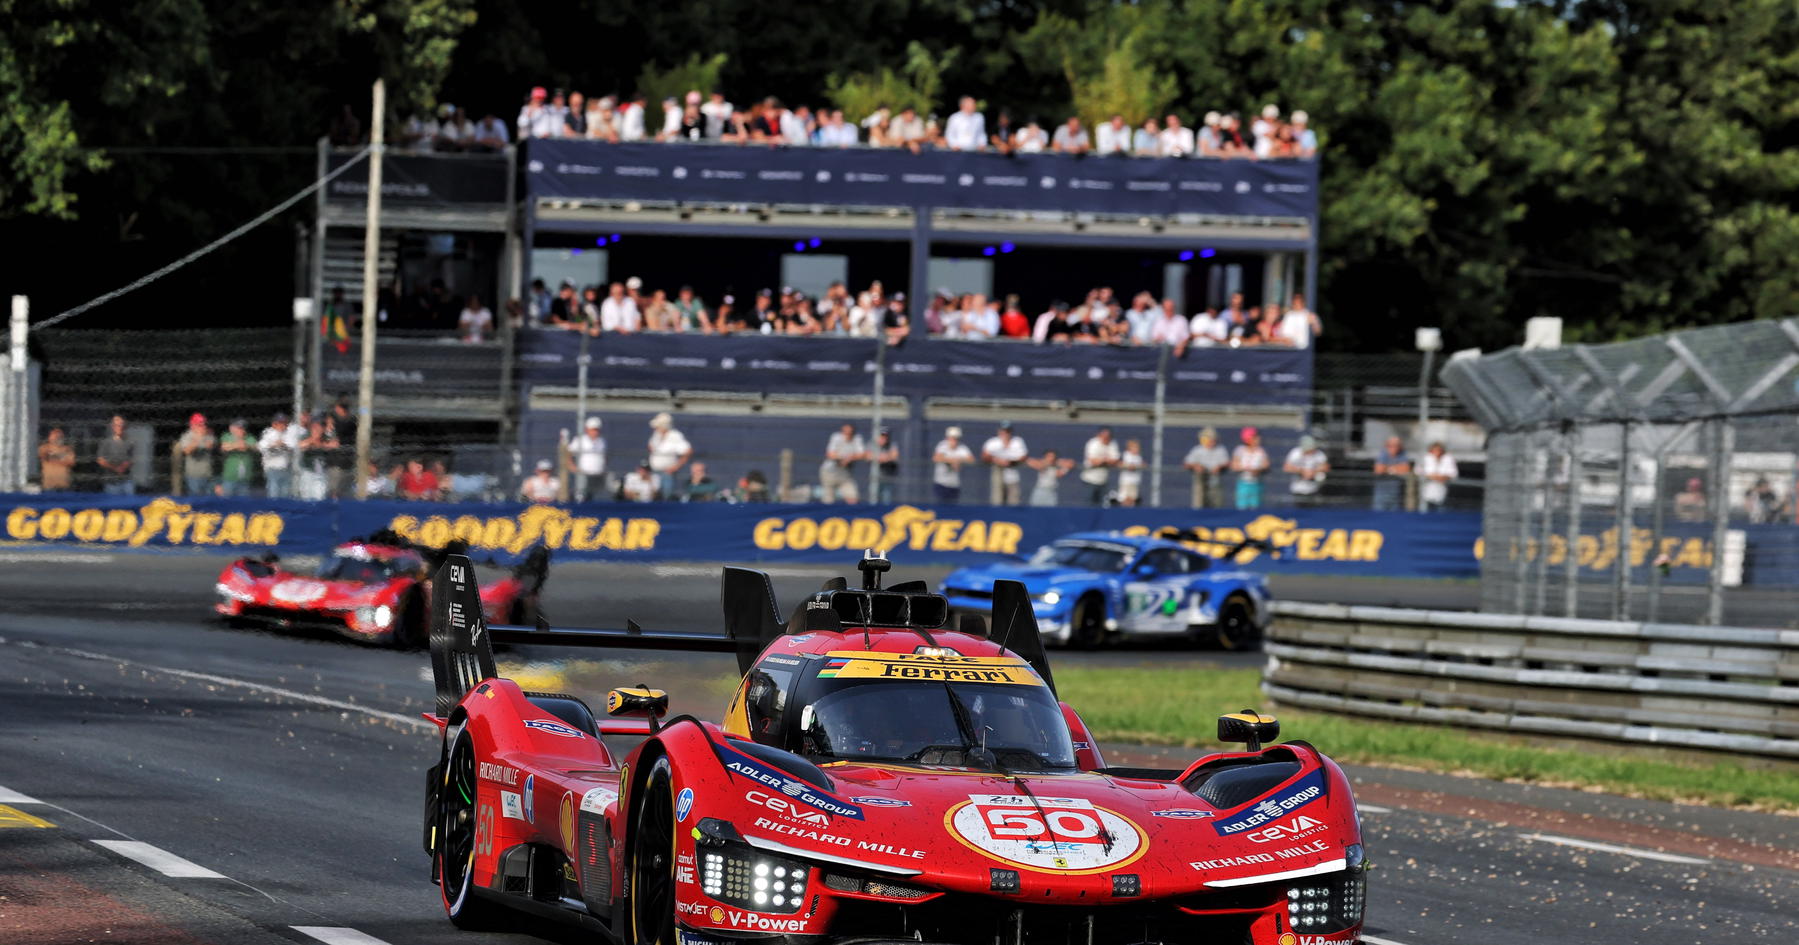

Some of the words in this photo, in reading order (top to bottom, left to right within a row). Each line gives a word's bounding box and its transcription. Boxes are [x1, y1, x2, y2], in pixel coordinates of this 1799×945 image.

[6, 498, 285, 546] GOODYEAR
[753, 505, 1023, 553] GOODYEAR
[1123, 515, 1384, 564] ODYEAR
[880, 662, 1015, 683] Ferrari
[479, 762, 502, 782] RICHARD
[503, 766, 520, 785] MILLE
[727, 761, 782, 788] ADLER
[801, 792, 857, 816] GROUP
[779, 814, 828, 830] LOGISTICS
[986, 809, 1100, 839] 50
[1222, 813, 1270, 833] ADLER
[1279, 786, 1320, 810] GROUP
[478, 804, 495, 856] 50
[754, 817, 852, 847] RICHARD
[857, 840, 927, 860] MILLE
[1288, 824, 1329, 841] LOGISTICS
[1189, 852, 1275, 871] RICHARD
[1275, 839, 1330, 859] MILLE
[728, 911, 808, 932] V-Power
